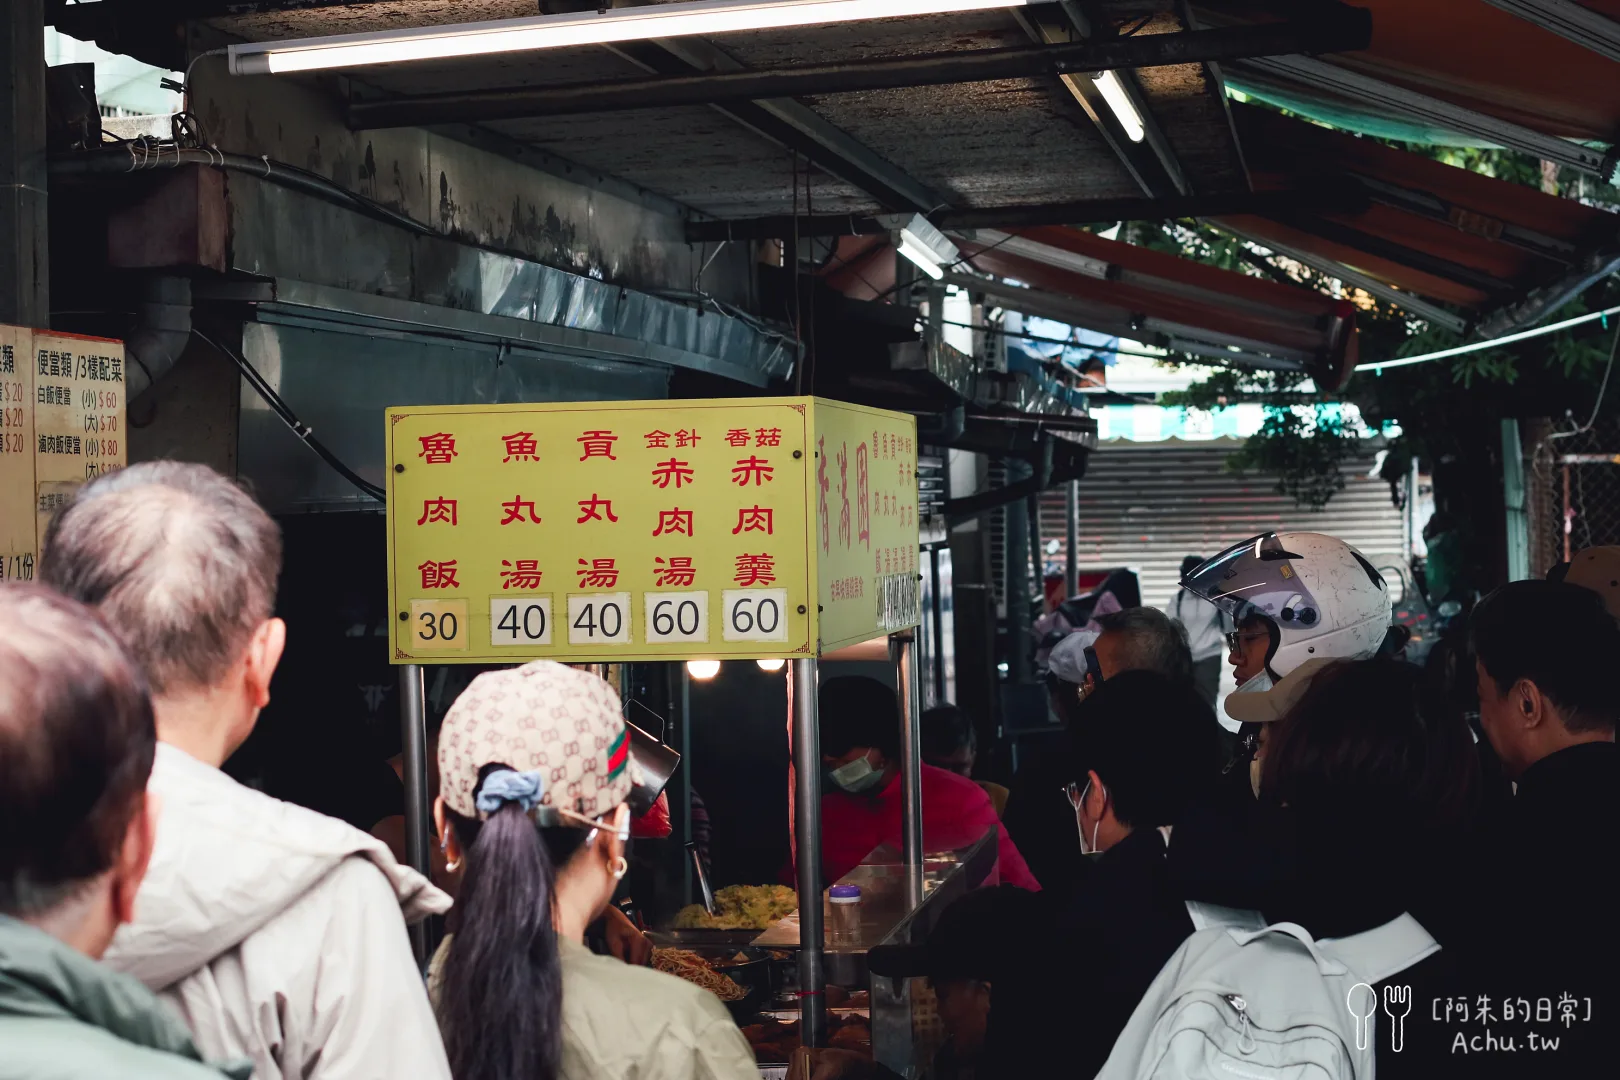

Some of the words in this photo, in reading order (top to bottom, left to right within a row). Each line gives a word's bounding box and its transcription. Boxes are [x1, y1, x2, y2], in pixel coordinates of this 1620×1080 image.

[0, 344, 14, 374] 類
[38, 385, 71, 405] 白飯便當
[418, 432, 460, 589] 魯肉飯
[500, 431, 543, 589] 魚丸湯
[576, 430, 619, 589] 貢丸湯
[418, 612, 458, 640] 30
[497, 604, 546, 639] 40
[573, 602, 622, 637] 40
[652, 600, 699, 635] 60
[732, 598, 779, 633] 60
